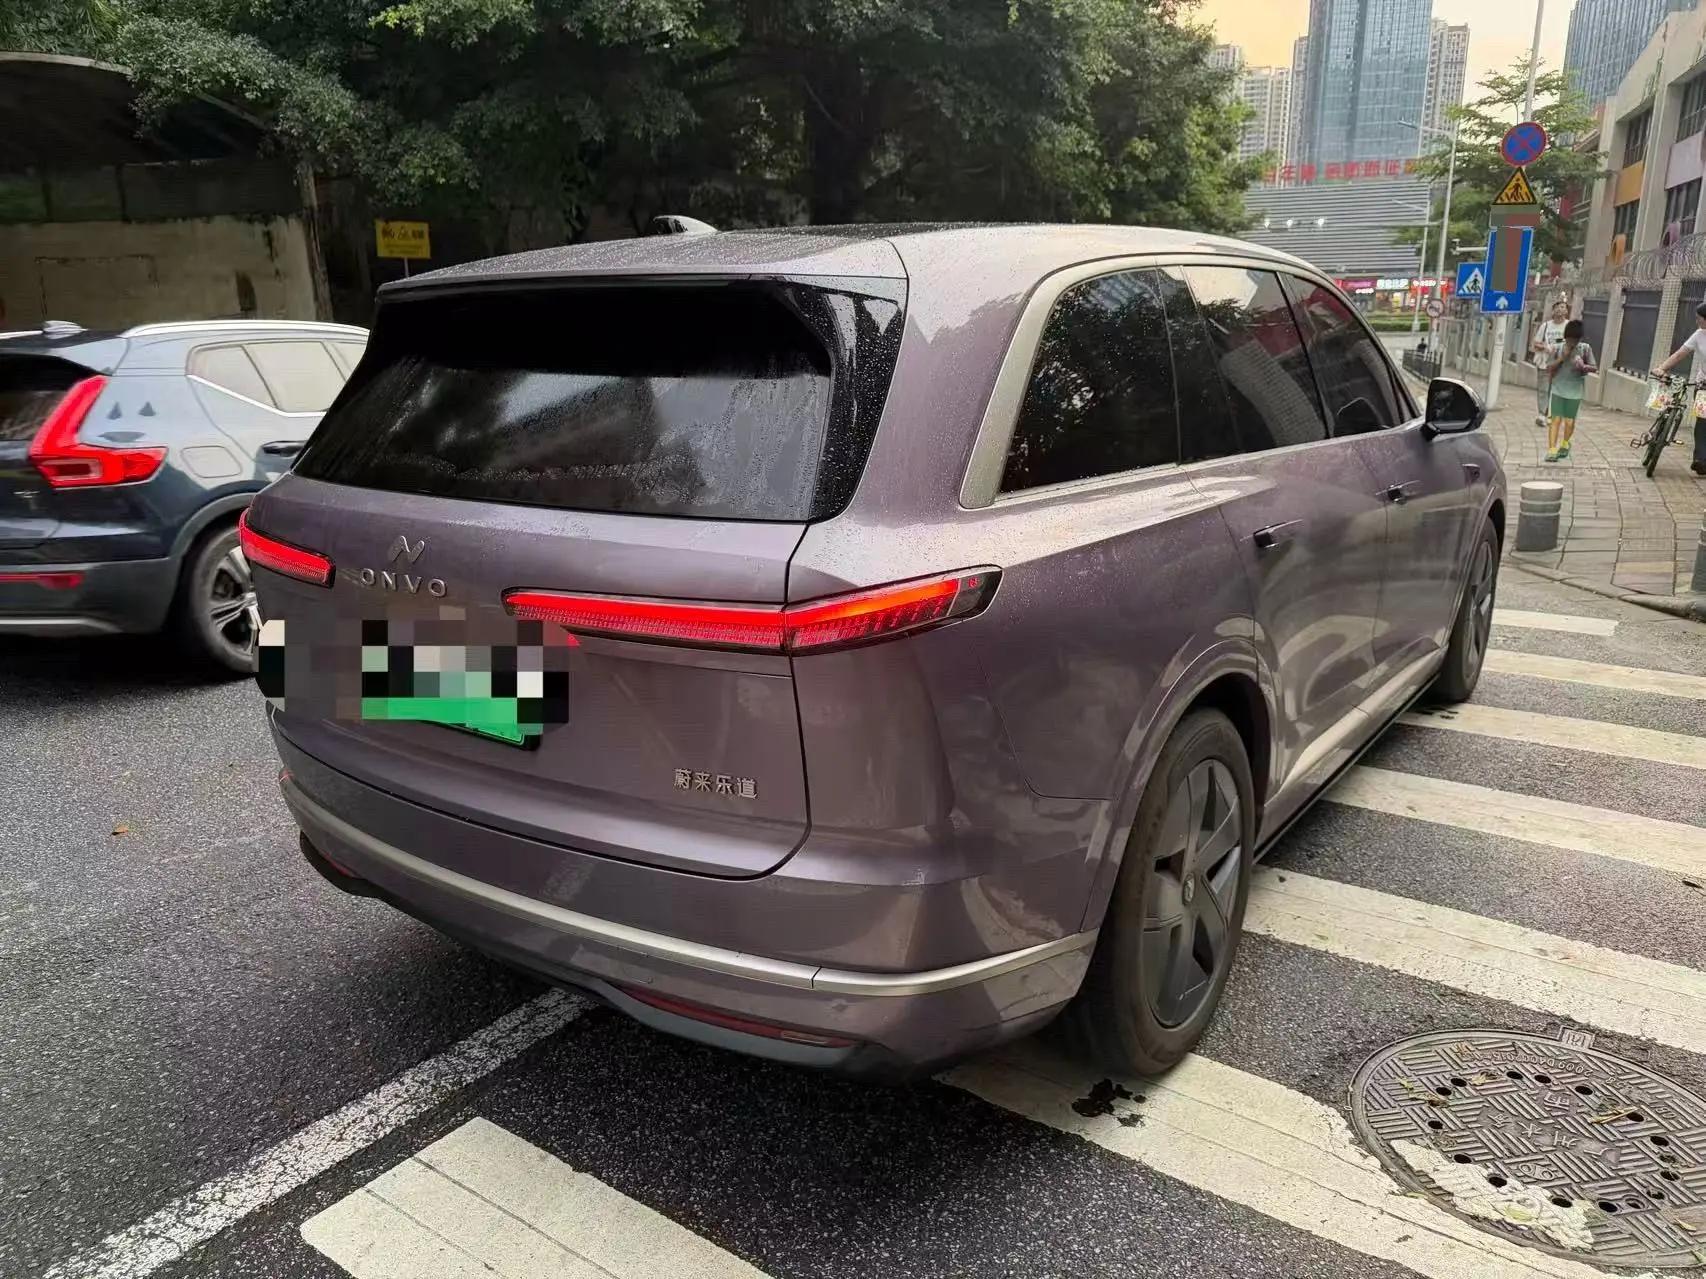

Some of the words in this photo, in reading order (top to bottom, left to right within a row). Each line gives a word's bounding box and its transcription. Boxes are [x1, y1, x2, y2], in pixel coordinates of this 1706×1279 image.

[360, 567, 448, 597] ONVO
[673, 767, 758, 800] 蔚来乐道
